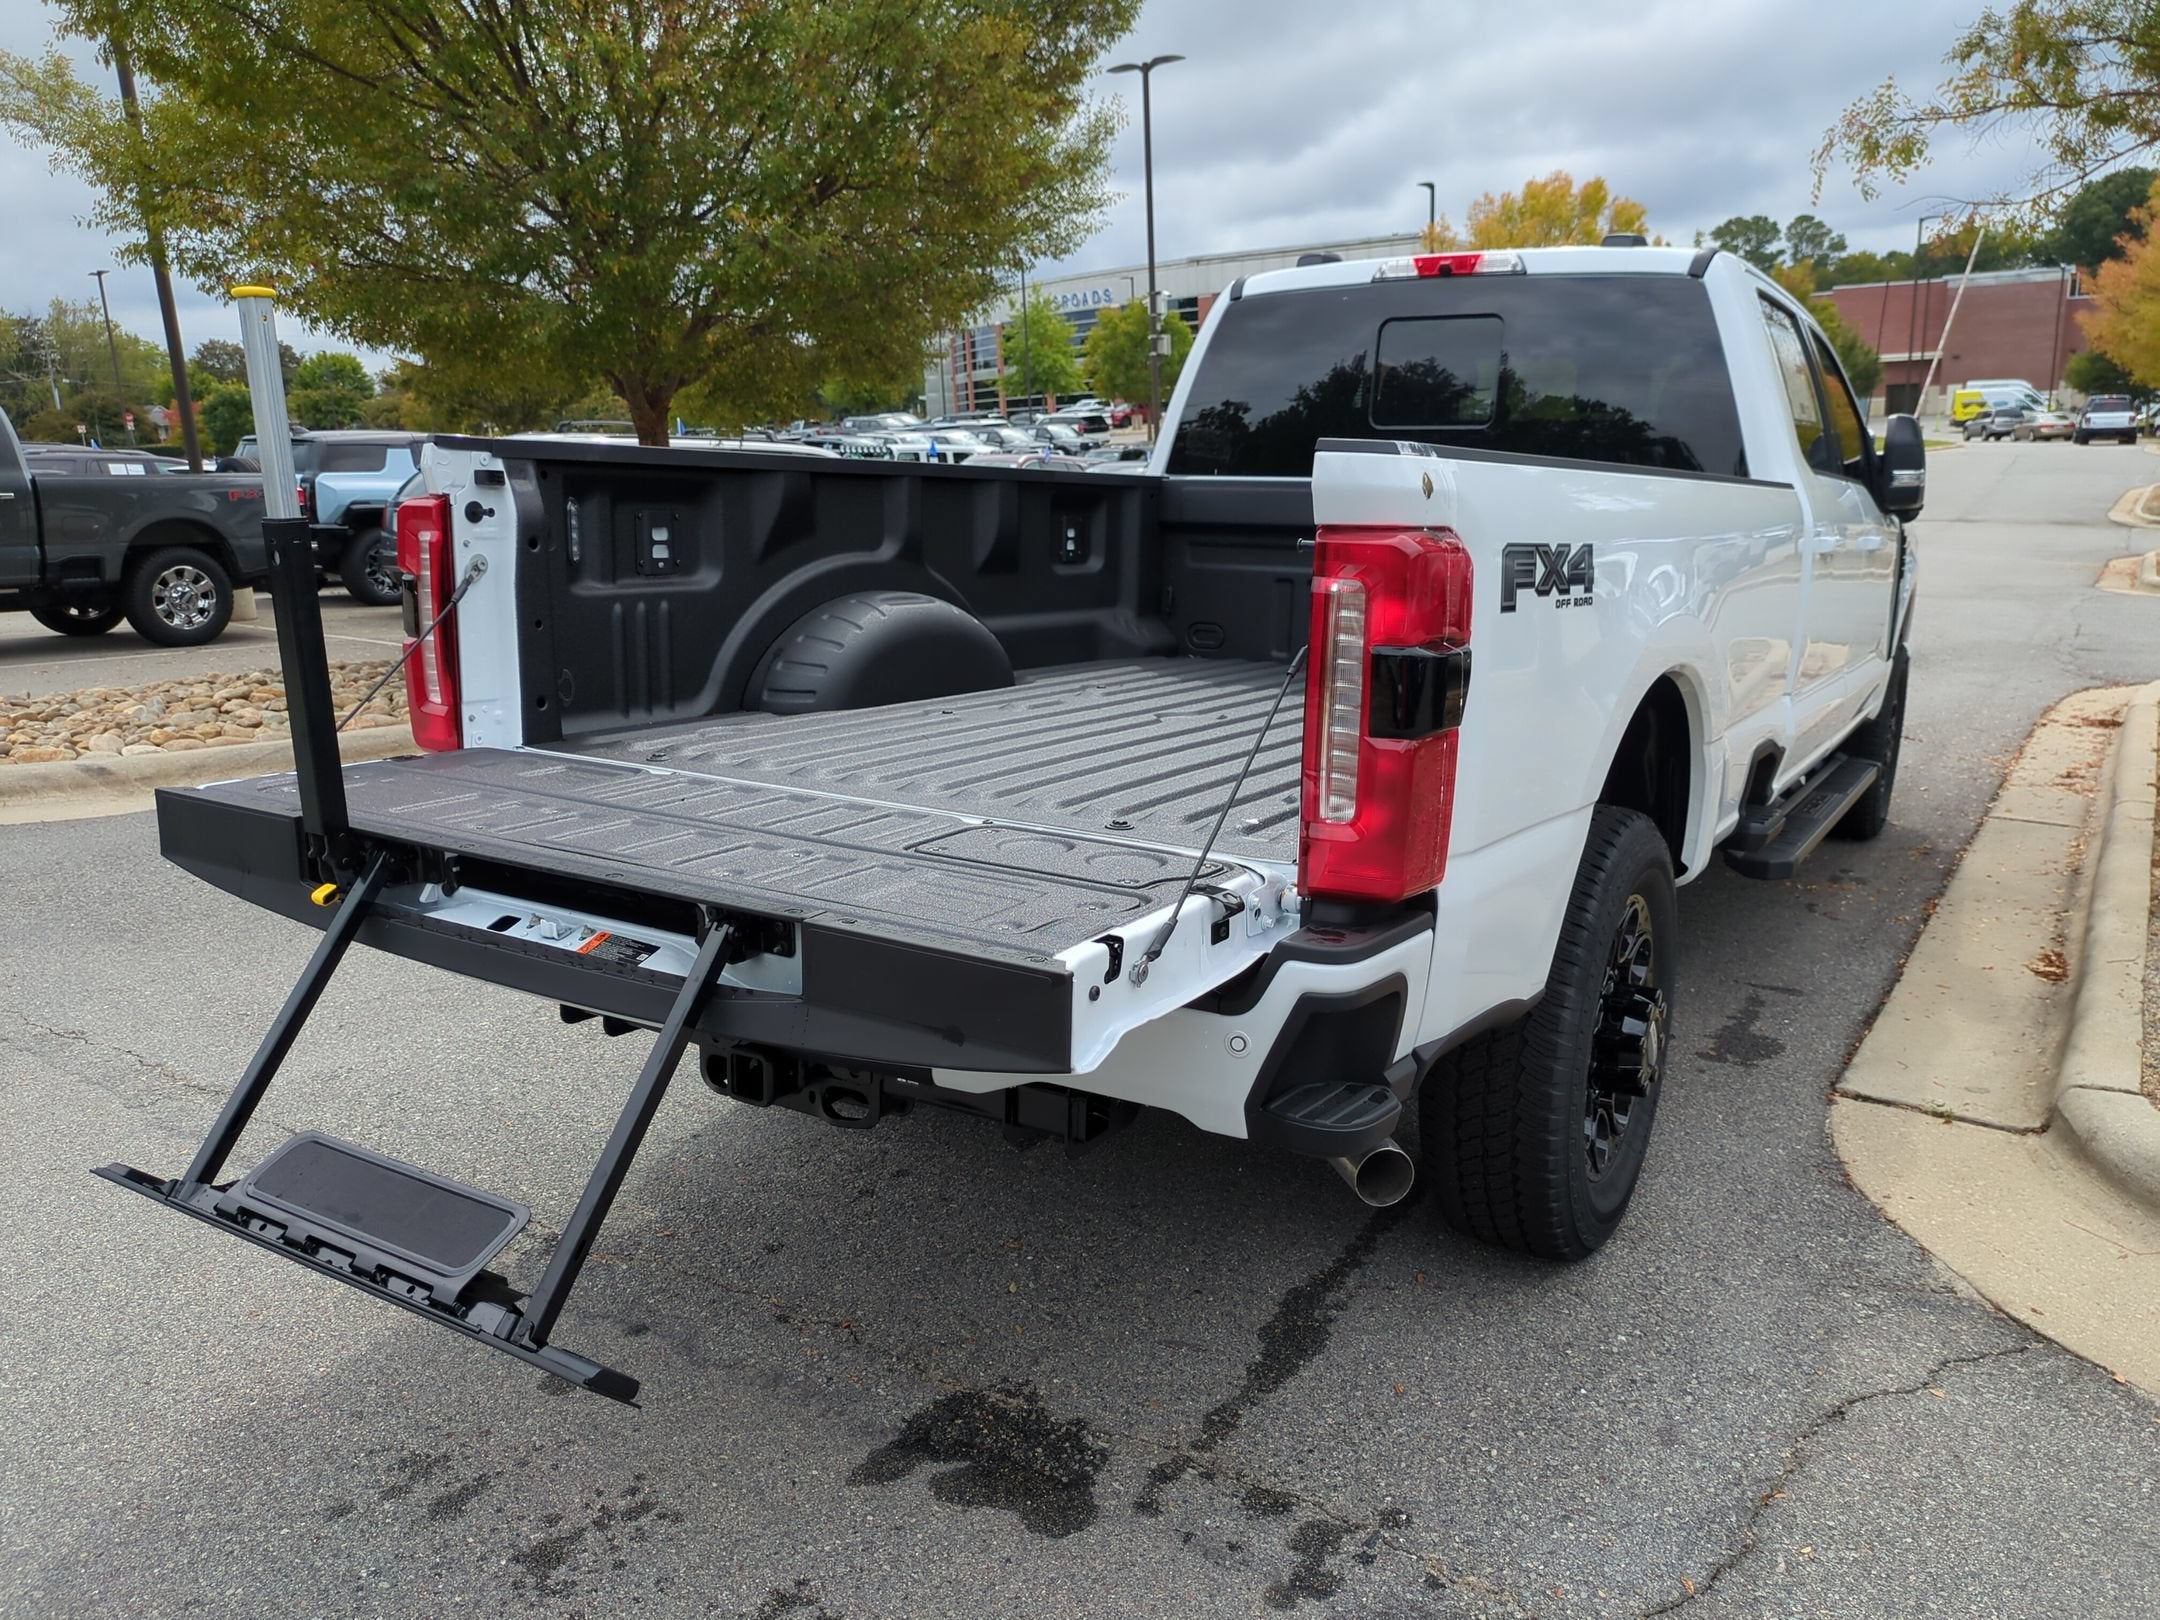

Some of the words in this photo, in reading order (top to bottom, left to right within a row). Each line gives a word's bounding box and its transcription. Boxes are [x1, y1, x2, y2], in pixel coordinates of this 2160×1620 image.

[1501, 542, 1594, 613] FX4
[1555, 599, 1571, 609] OFF
[1574, 597, 1593, 608] ROAD
